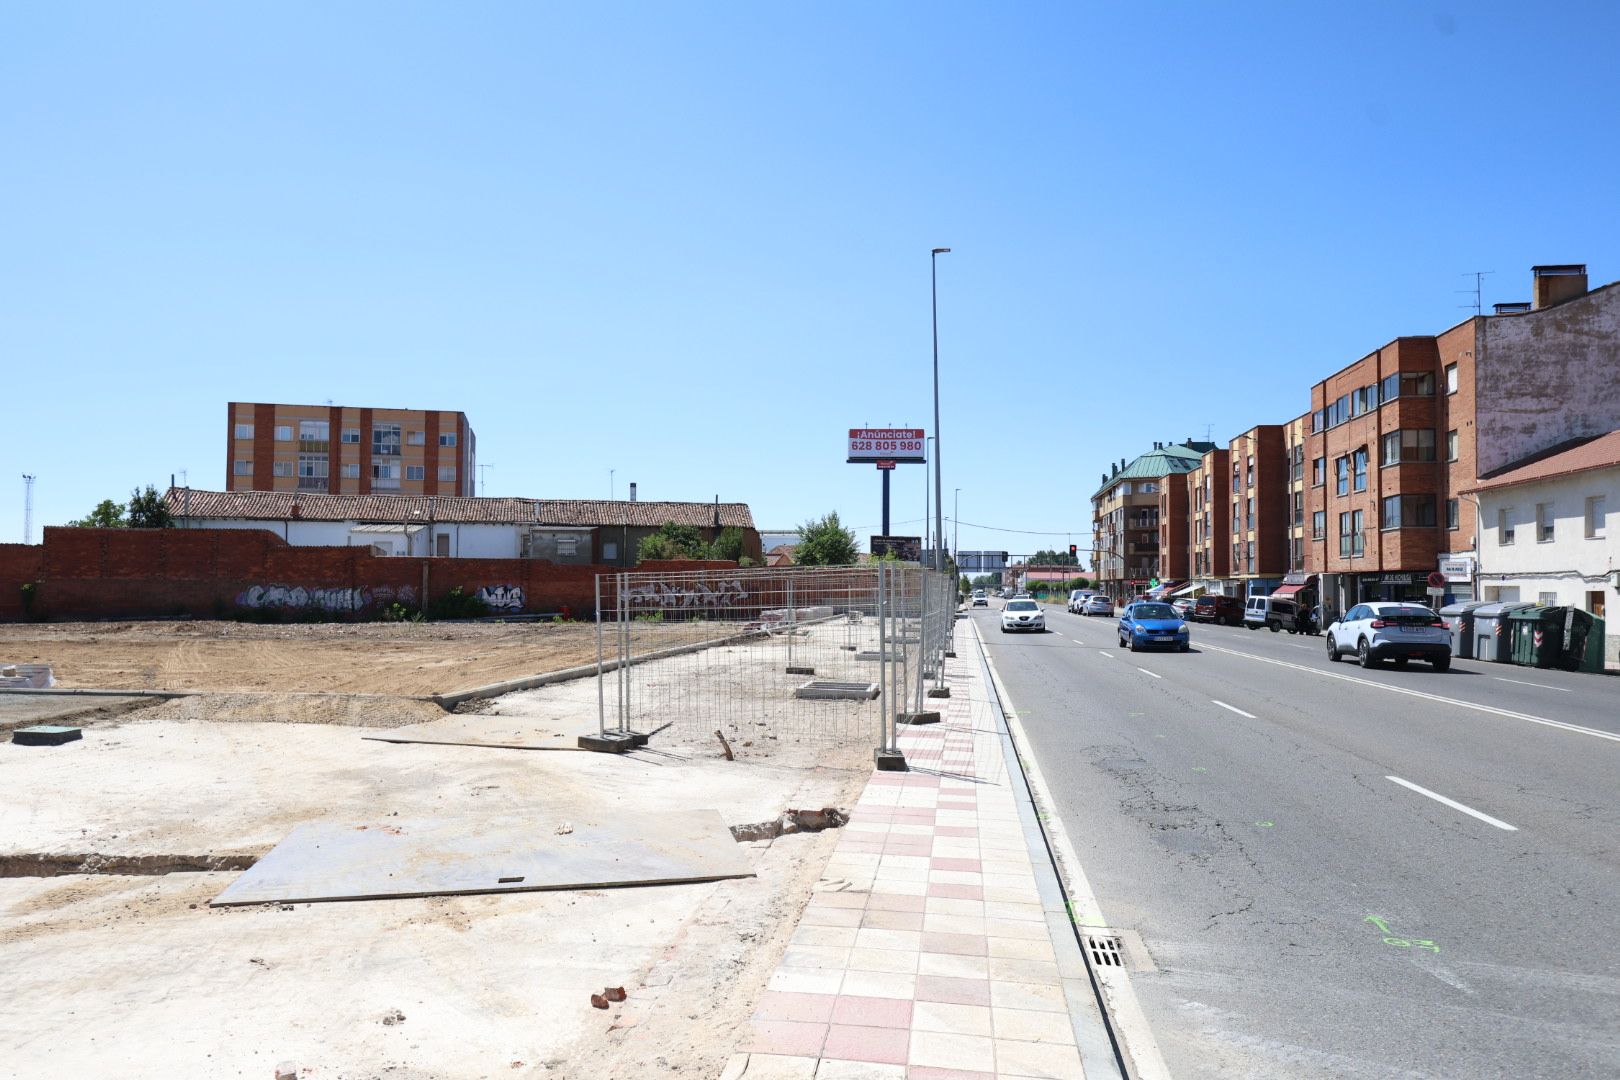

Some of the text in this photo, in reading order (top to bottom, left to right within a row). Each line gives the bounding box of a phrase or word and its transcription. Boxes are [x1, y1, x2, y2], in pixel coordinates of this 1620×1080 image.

[857, 430, 916, 439] ¡Anúnciate!
[851, 441, 922, 451] 628 805 980
